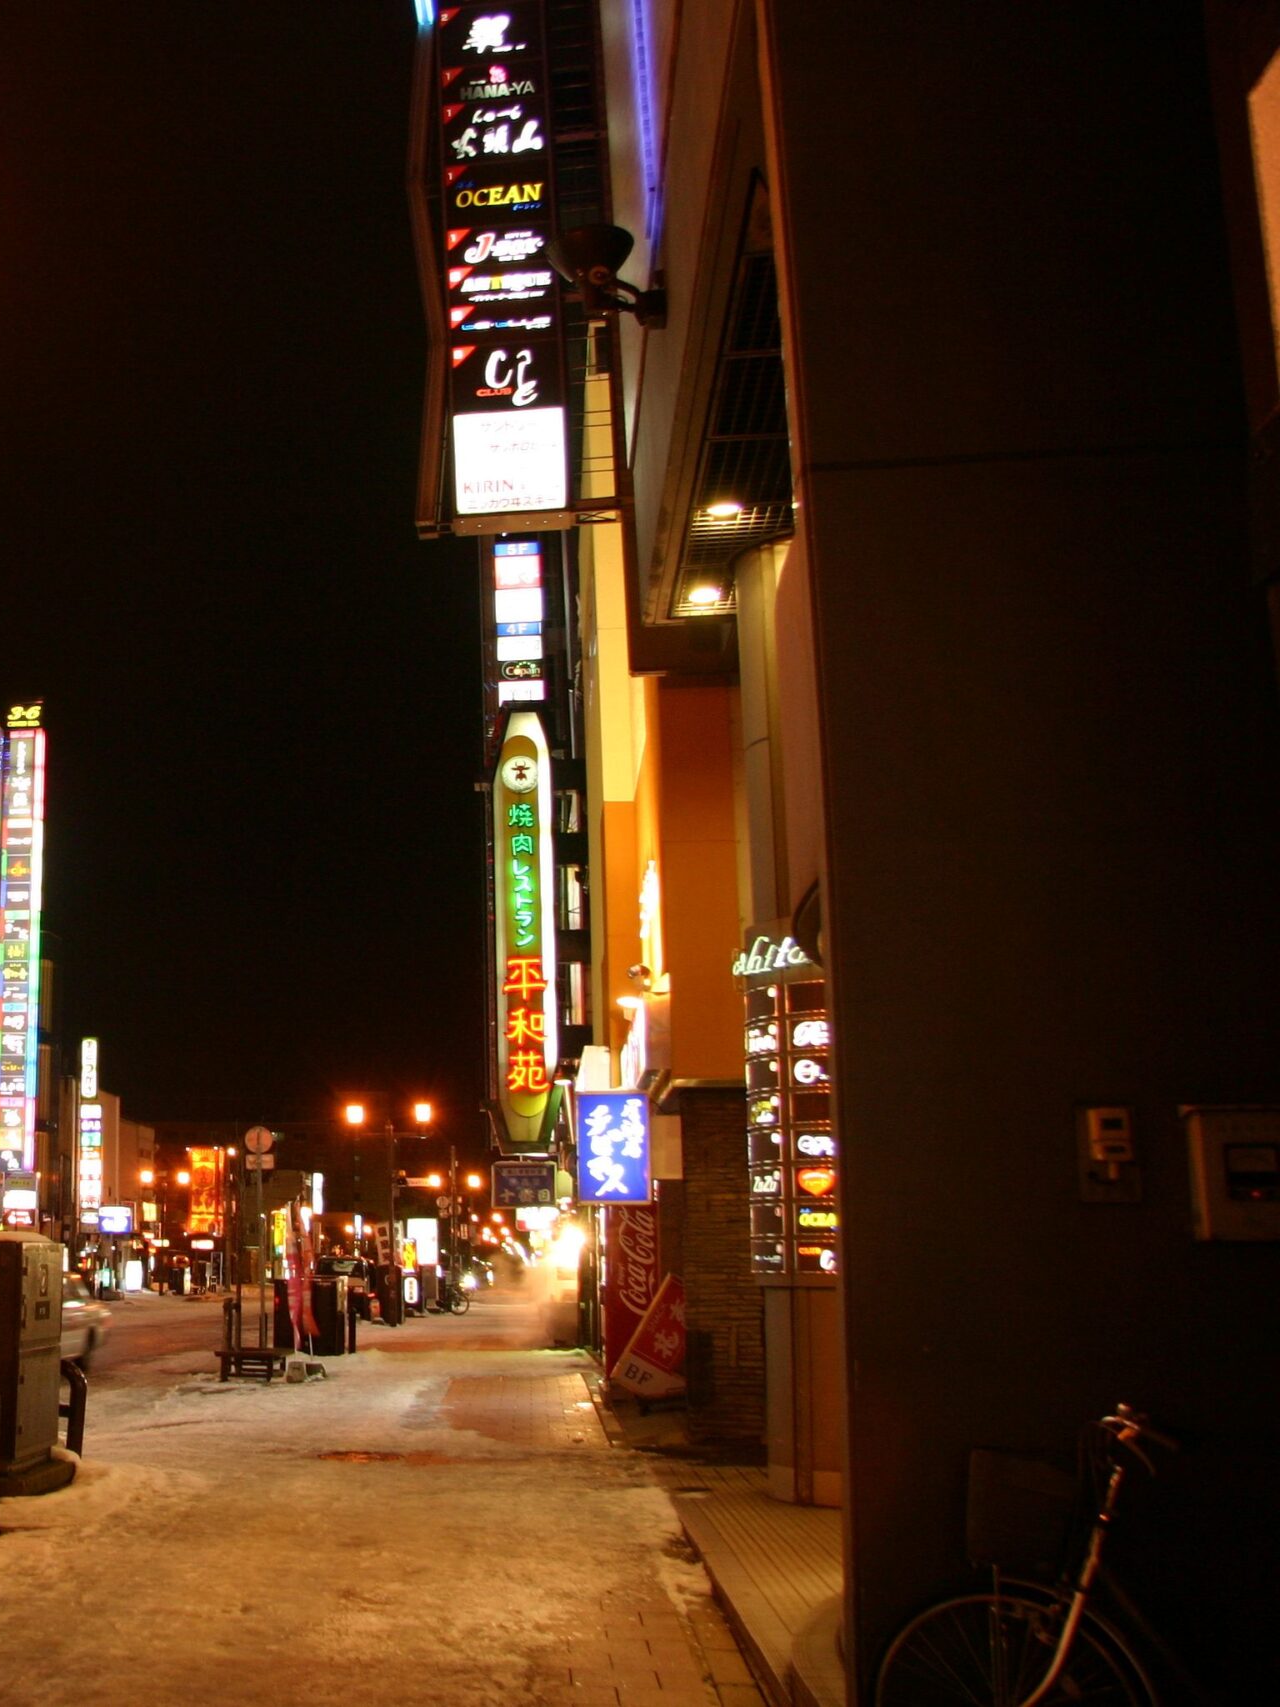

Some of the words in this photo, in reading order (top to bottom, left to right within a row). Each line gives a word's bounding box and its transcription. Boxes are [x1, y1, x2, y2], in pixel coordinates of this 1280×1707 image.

[460, 81, 535, 100] HANA-YA
[455, 183, 544, 208] OCEAN
[463, 479, 514, 494] KIRIN
[506, 544, 530, 555] 5F
[506, 625, 528, 635] 4F
[507, 800, 535, 948] 焼肉レストラン
[503, 956, 549, 1094] 平和苑
[624, 1363, 654, 1386] BF
